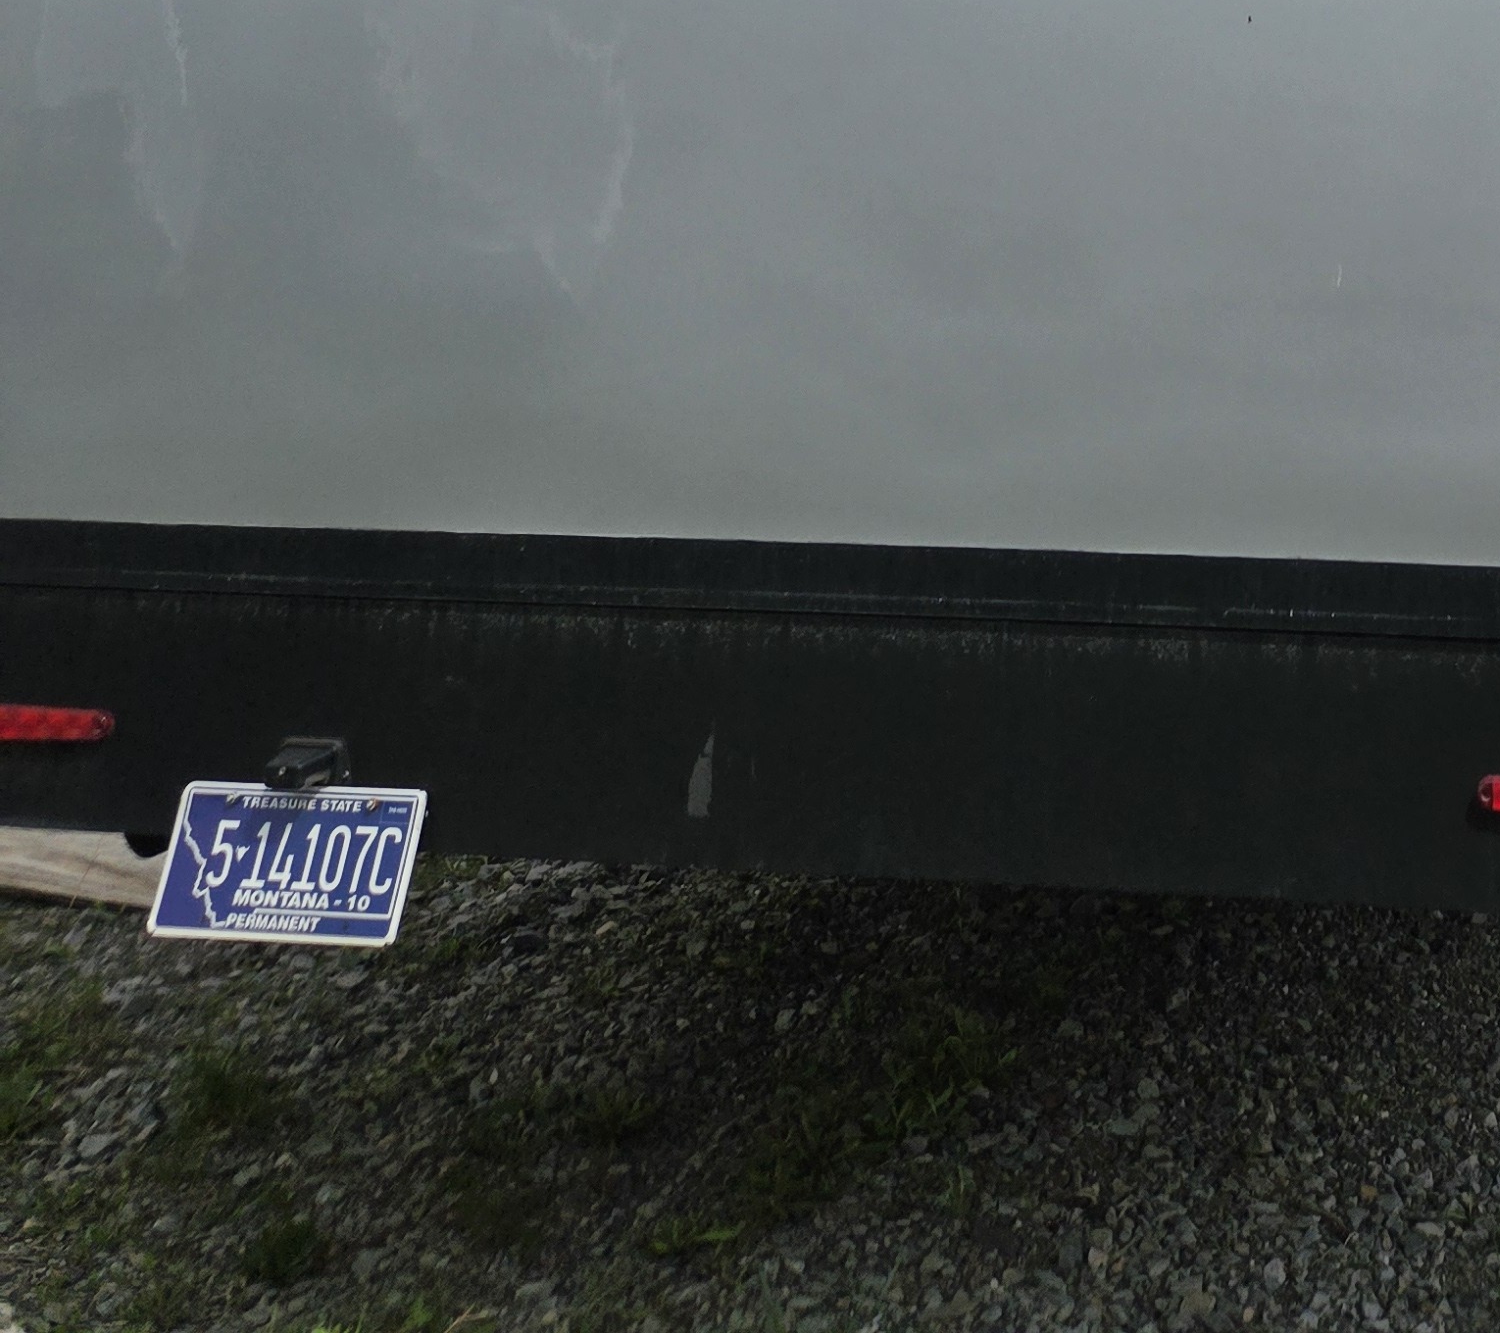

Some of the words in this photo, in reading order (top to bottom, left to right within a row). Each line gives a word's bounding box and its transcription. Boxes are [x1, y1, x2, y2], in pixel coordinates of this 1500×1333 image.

[242, 795, 316, 811] TREASURE
[320, 799, 362, 813] STATE
[232, 889, 329, 909] MONTANA
[346, 894, 371, 911] 10
[224, 912, 321, 932] PERMANENT
